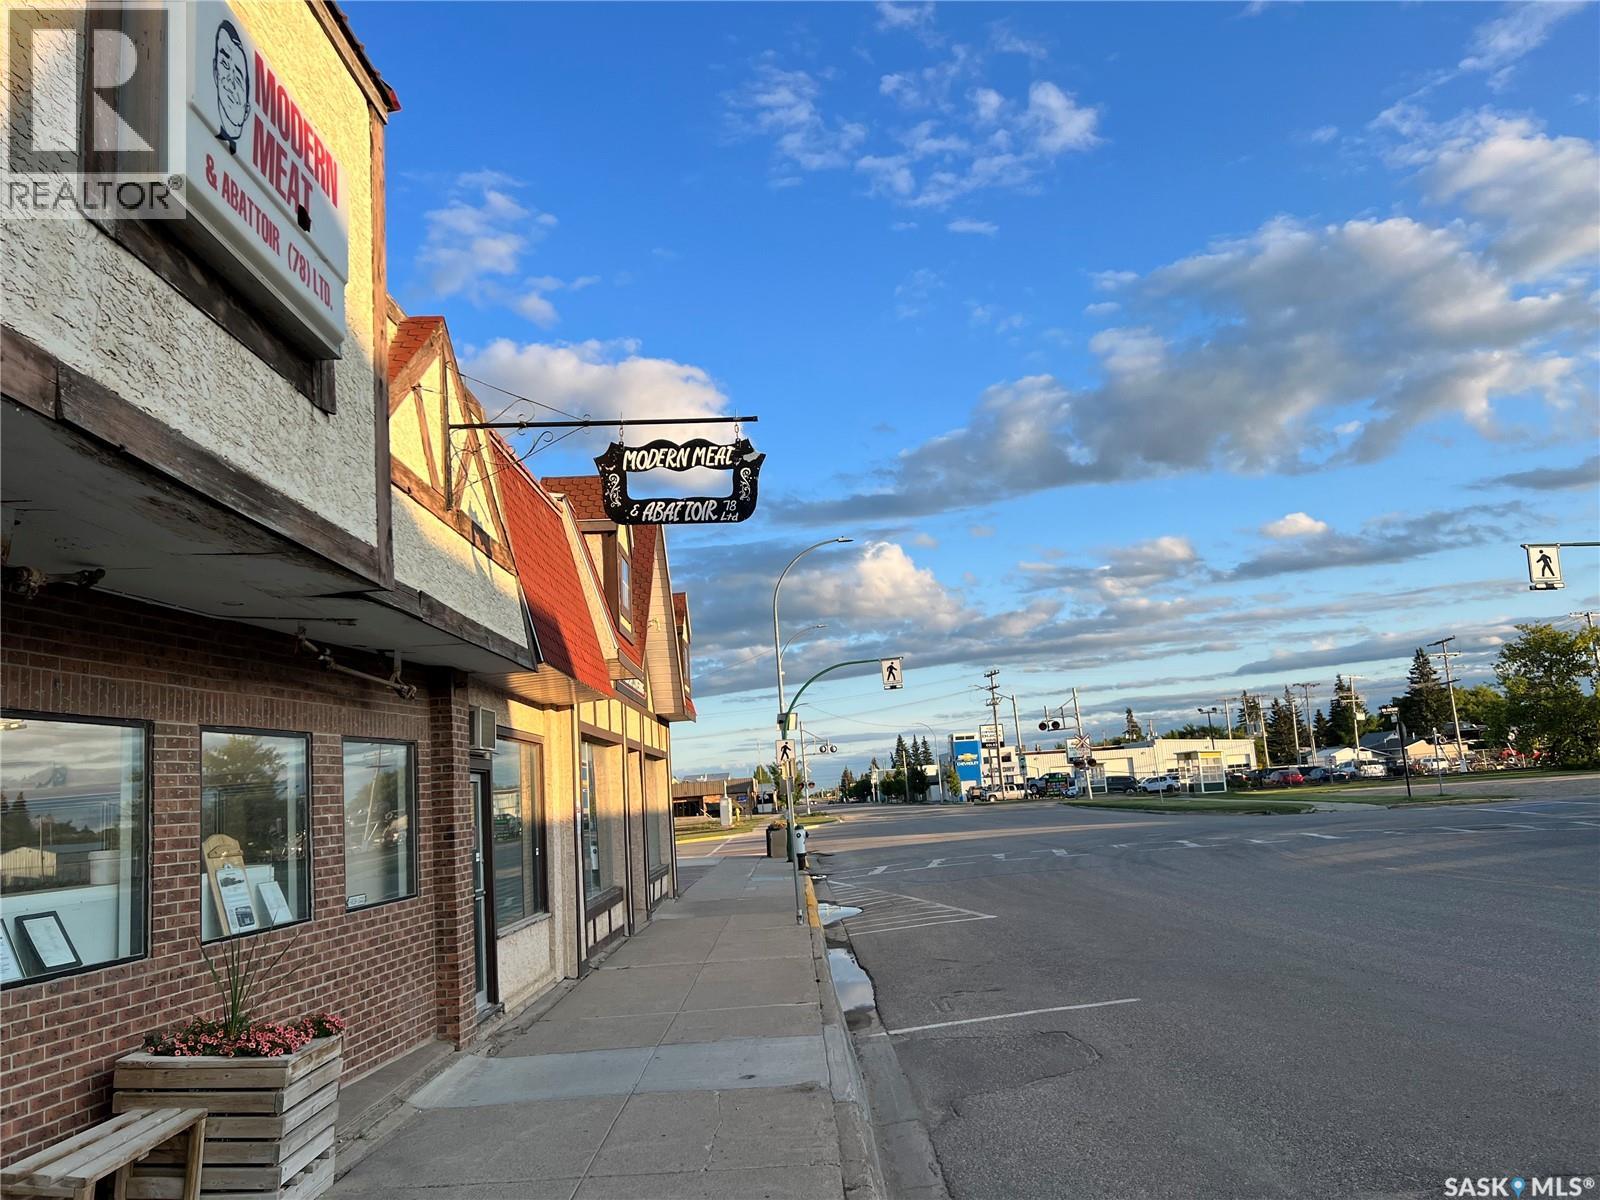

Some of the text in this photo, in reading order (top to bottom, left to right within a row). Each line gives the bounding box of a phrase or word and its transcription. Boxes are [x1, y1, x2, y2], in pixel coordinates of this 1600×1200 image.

[255, 50, 338, 208] MODERN
[252, 112, 313, 215] MEAT
[206, 153, 334, 311] & ABATTOIR (78) LTD.
[622, 445, 736, 471] MODERN MEAT
[641, 499, 718, 522] ABATTOIR
[720, 511, 739, 521] Ltd
[722, 499, 737, 511] 78
